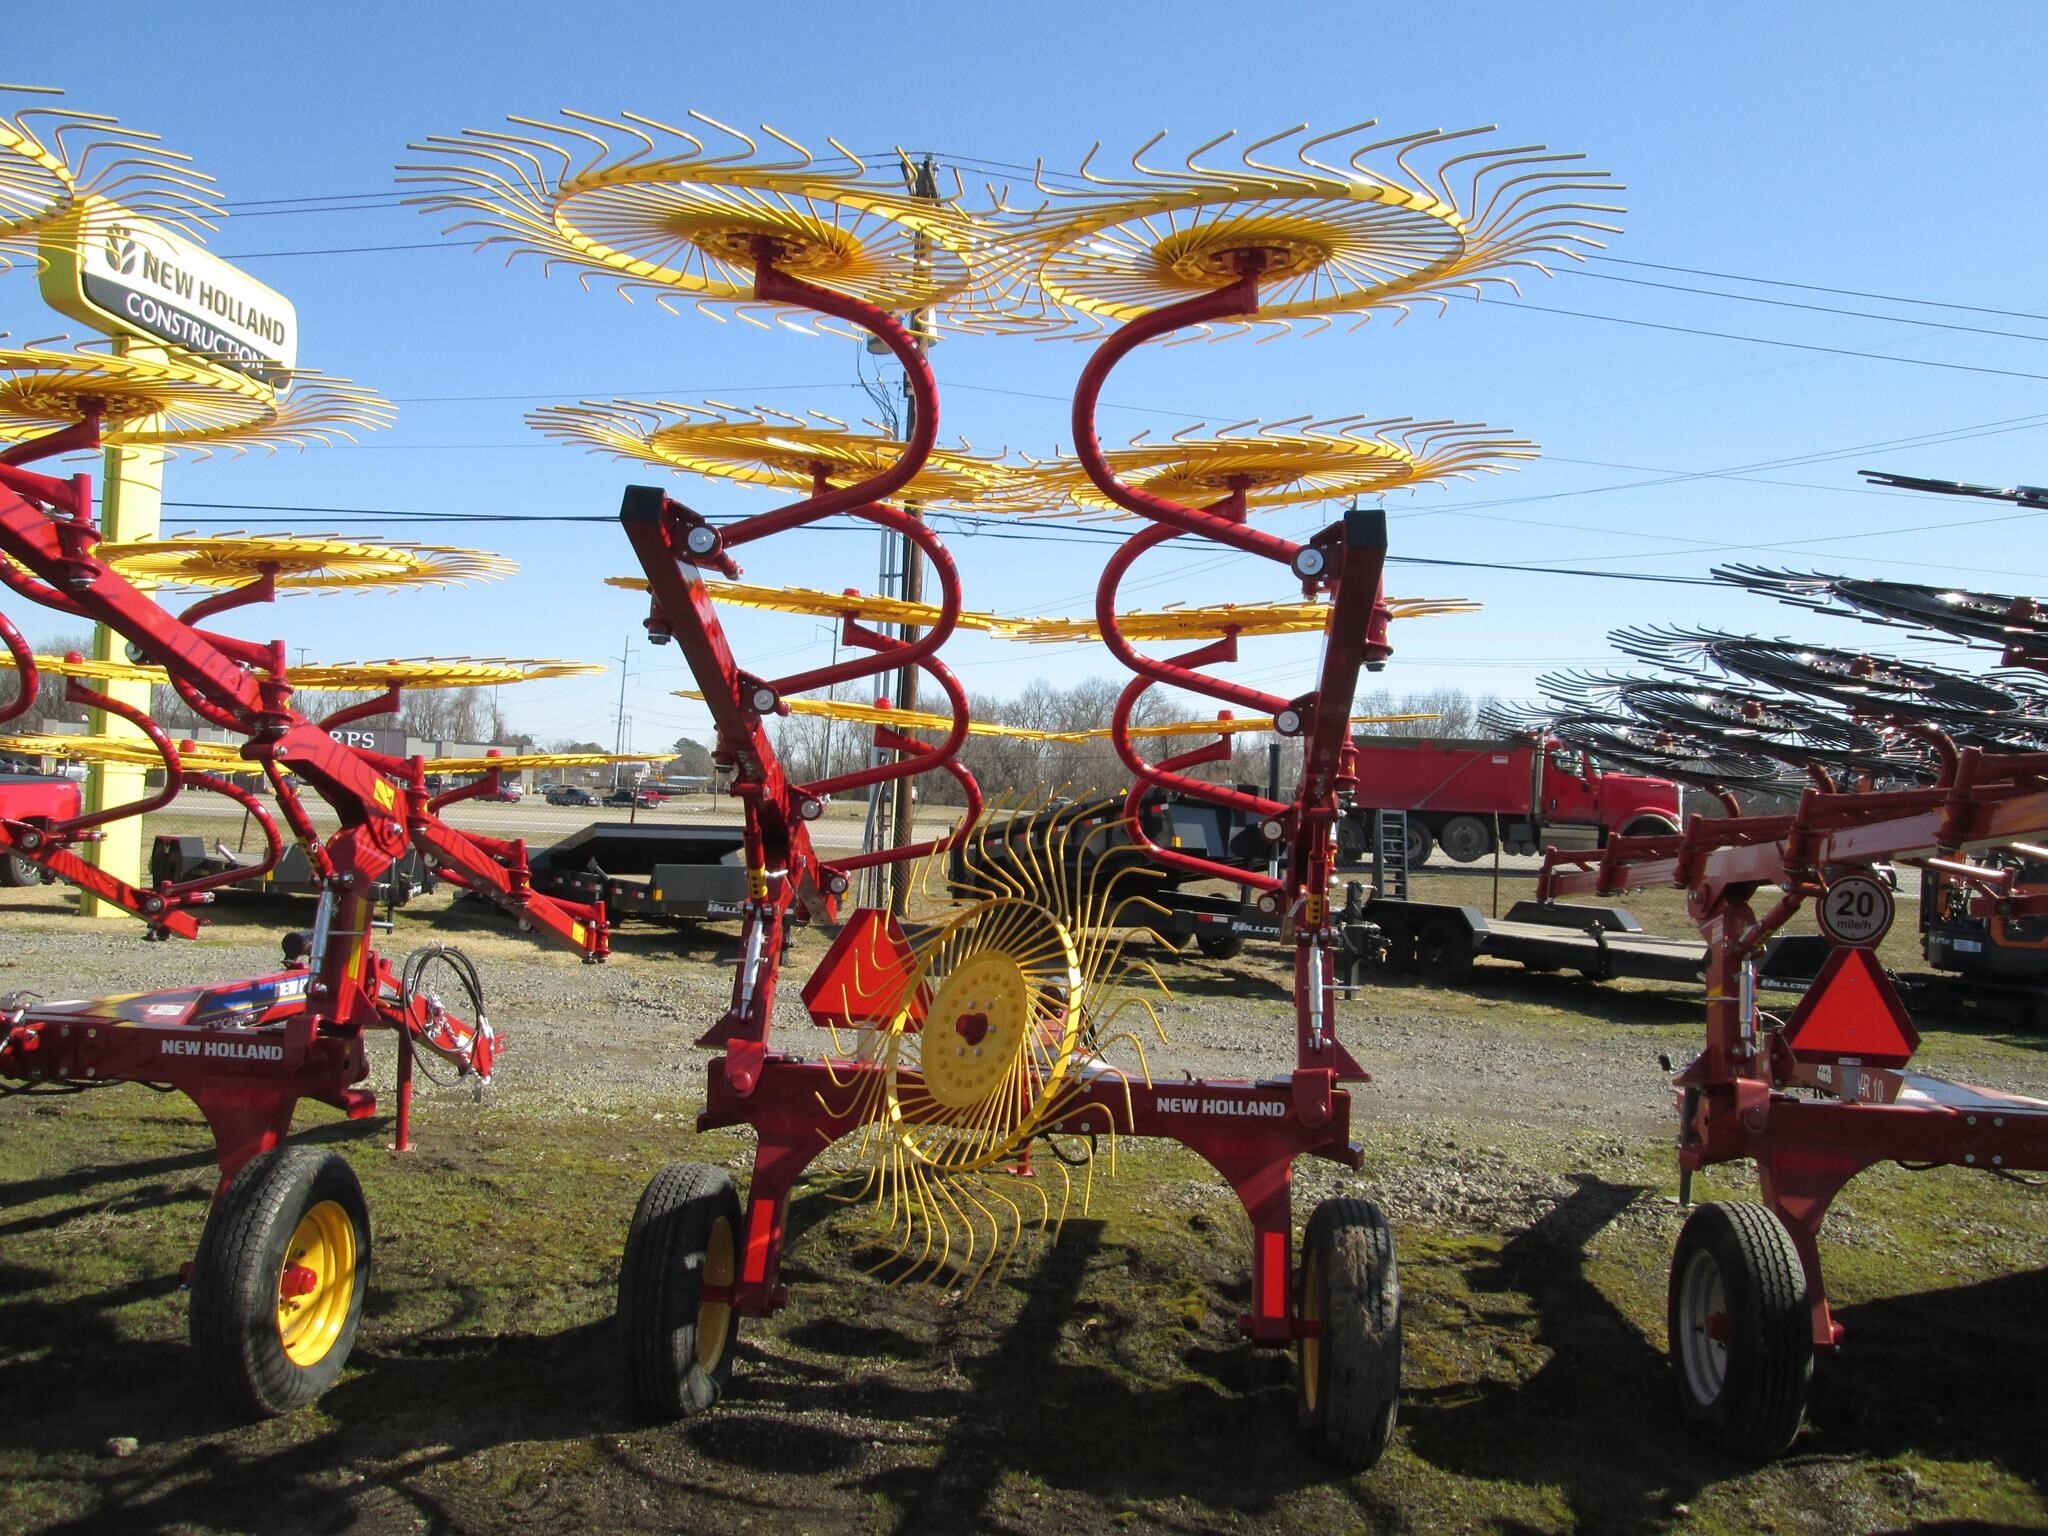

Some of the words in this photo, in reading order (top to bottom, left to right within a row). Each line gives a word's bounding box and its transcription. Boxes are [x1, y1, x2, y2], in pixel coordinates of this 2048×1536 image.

[142, 251, 194, 300] NEW
[199, 281, 285, 346] HOLLAND
[126, 292, 265, 375] CONSTRUCTION
[1836, 890, 1874, 917] 20
[1837, 920, 1871, 930] mile/h
[161, 1040, 201, 1056] NEW
[204, 1042, 284, 1061] HOLLAND
[1157, 1098, 1199, 1114] NEW
[1202, 1100, 1286, 1117] HOLLAND
